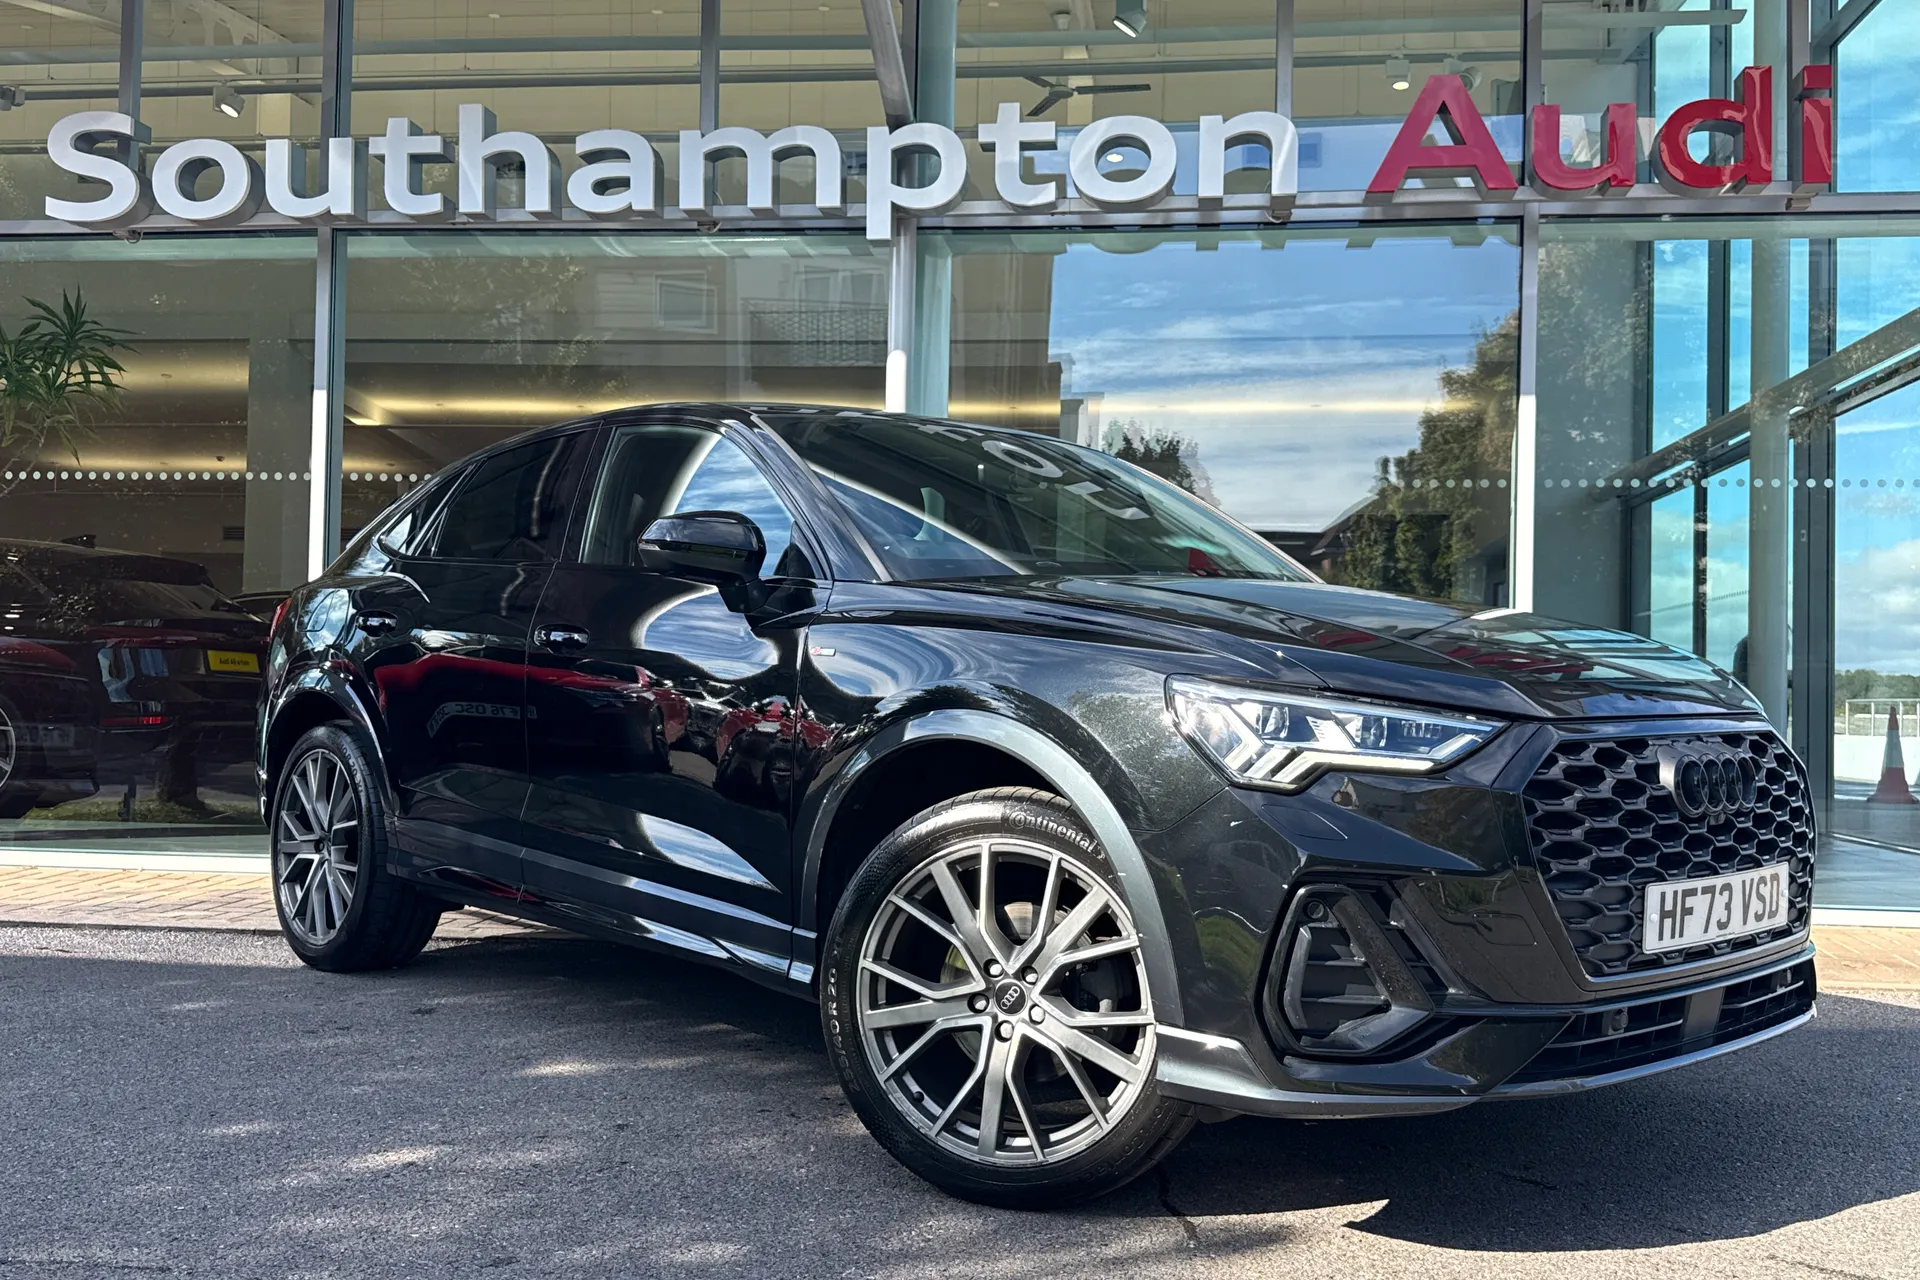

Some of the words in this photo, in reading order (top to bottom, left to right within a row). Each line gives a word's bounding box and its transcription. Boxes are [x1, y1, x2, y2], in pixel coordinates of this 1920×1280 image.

[44, 102, 1299, 241] Southampton
[1367, 65, 1832, 197] Audi
[1657, 882, 1734, 942] HF73
[1740, 872, 1780, 927] VSD
